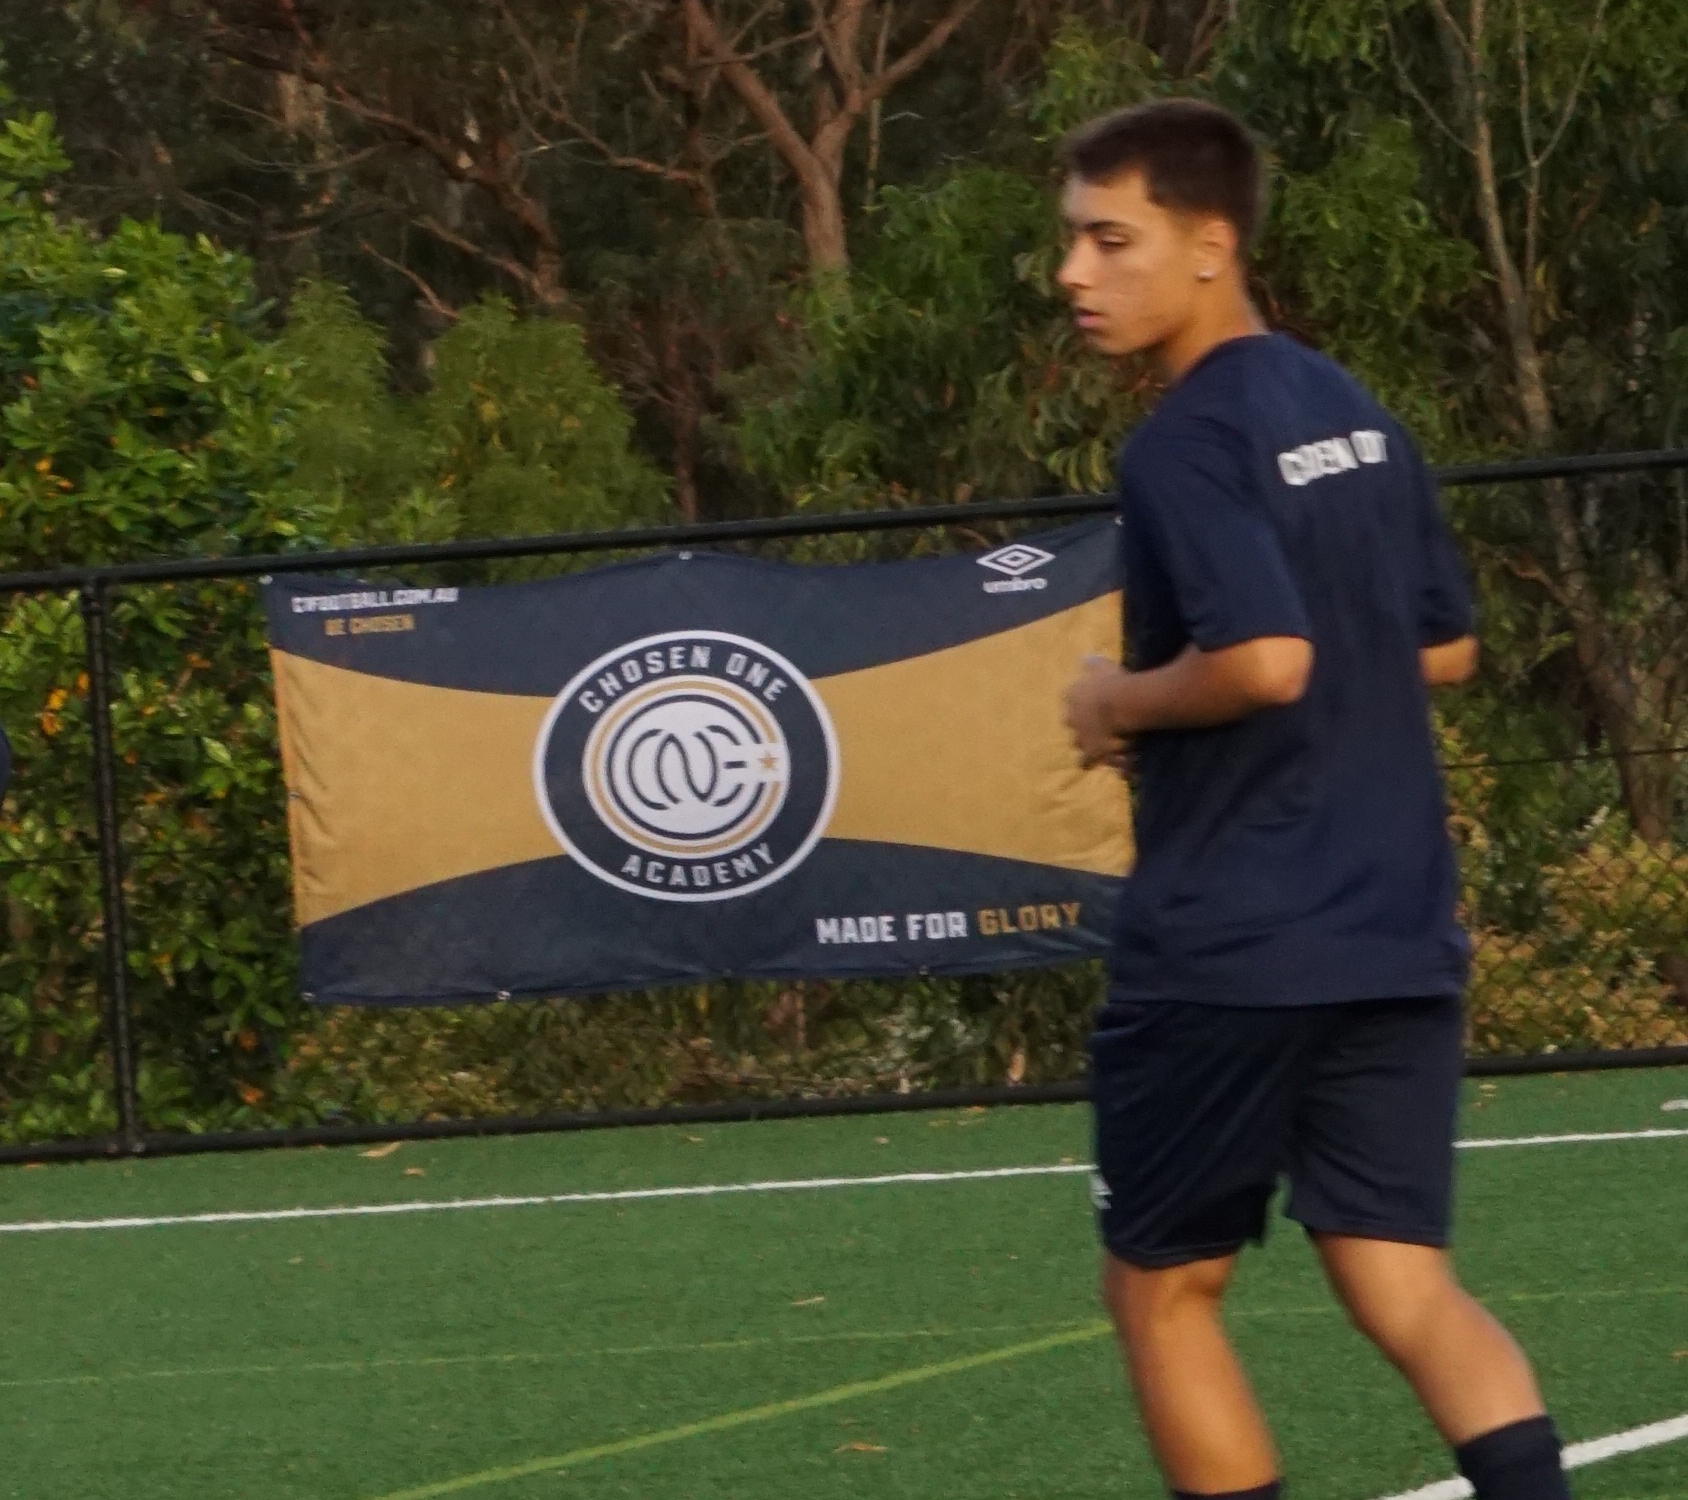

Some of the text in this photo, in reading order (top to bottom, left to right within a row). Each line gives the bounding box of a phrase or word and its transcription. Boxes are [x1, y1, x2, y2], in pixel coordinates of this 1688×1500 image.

[578, 645, 788, 713] CHOSEN ONE
[621, 842, 774, 887] ACADEMY
[816, 902, 1081, 944] MADE FOR GLORY
